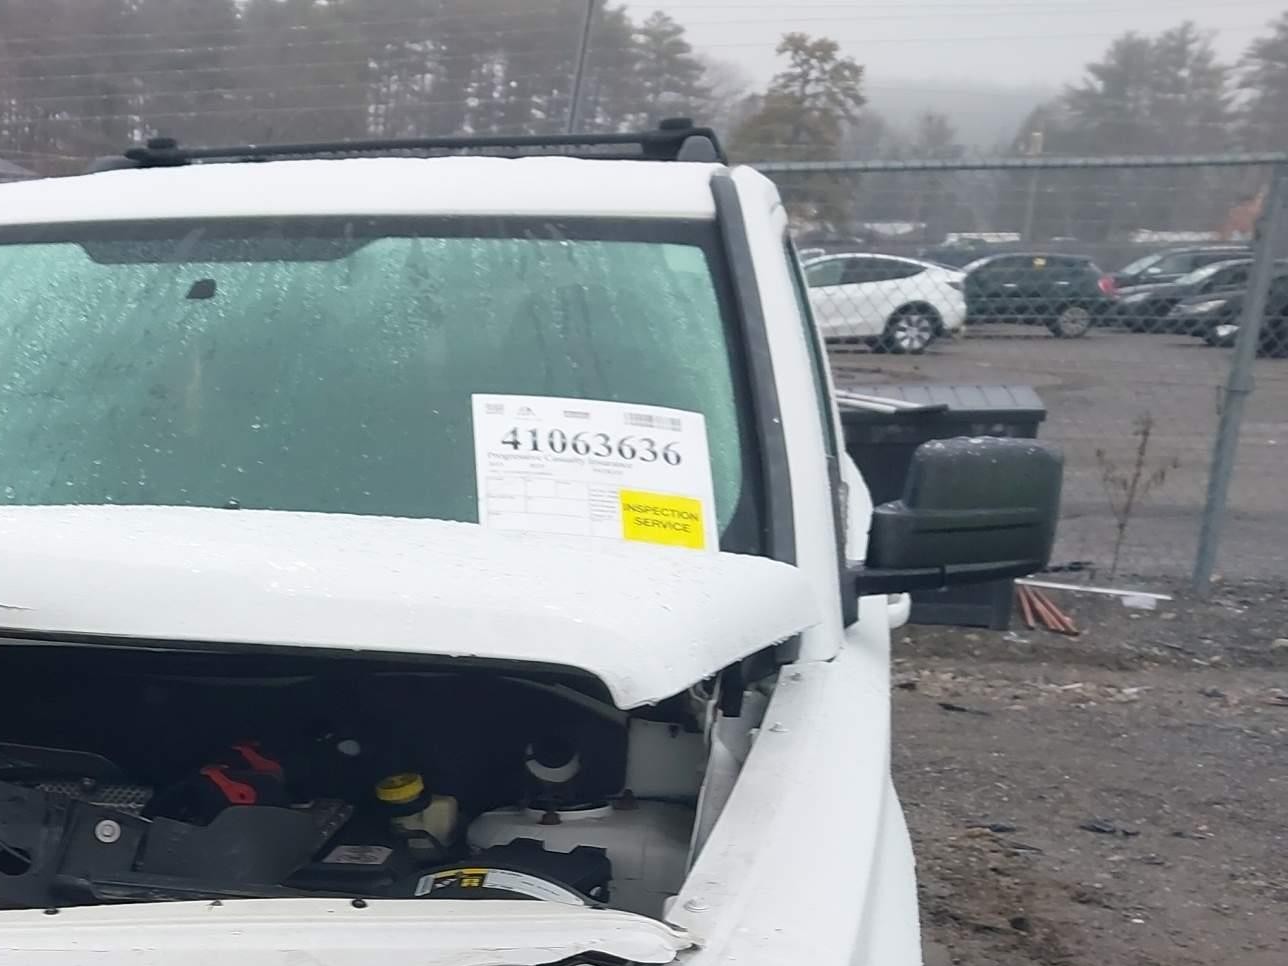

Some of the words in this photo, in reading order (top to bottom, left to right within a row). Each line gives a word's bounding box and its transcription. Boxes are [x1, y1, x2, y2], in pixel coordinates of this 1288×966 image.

[501, 426, 682, 466] 41063636
[623, 503, 700, 522] INSPECTION
[633, 516, 691, 533] SERVICE
